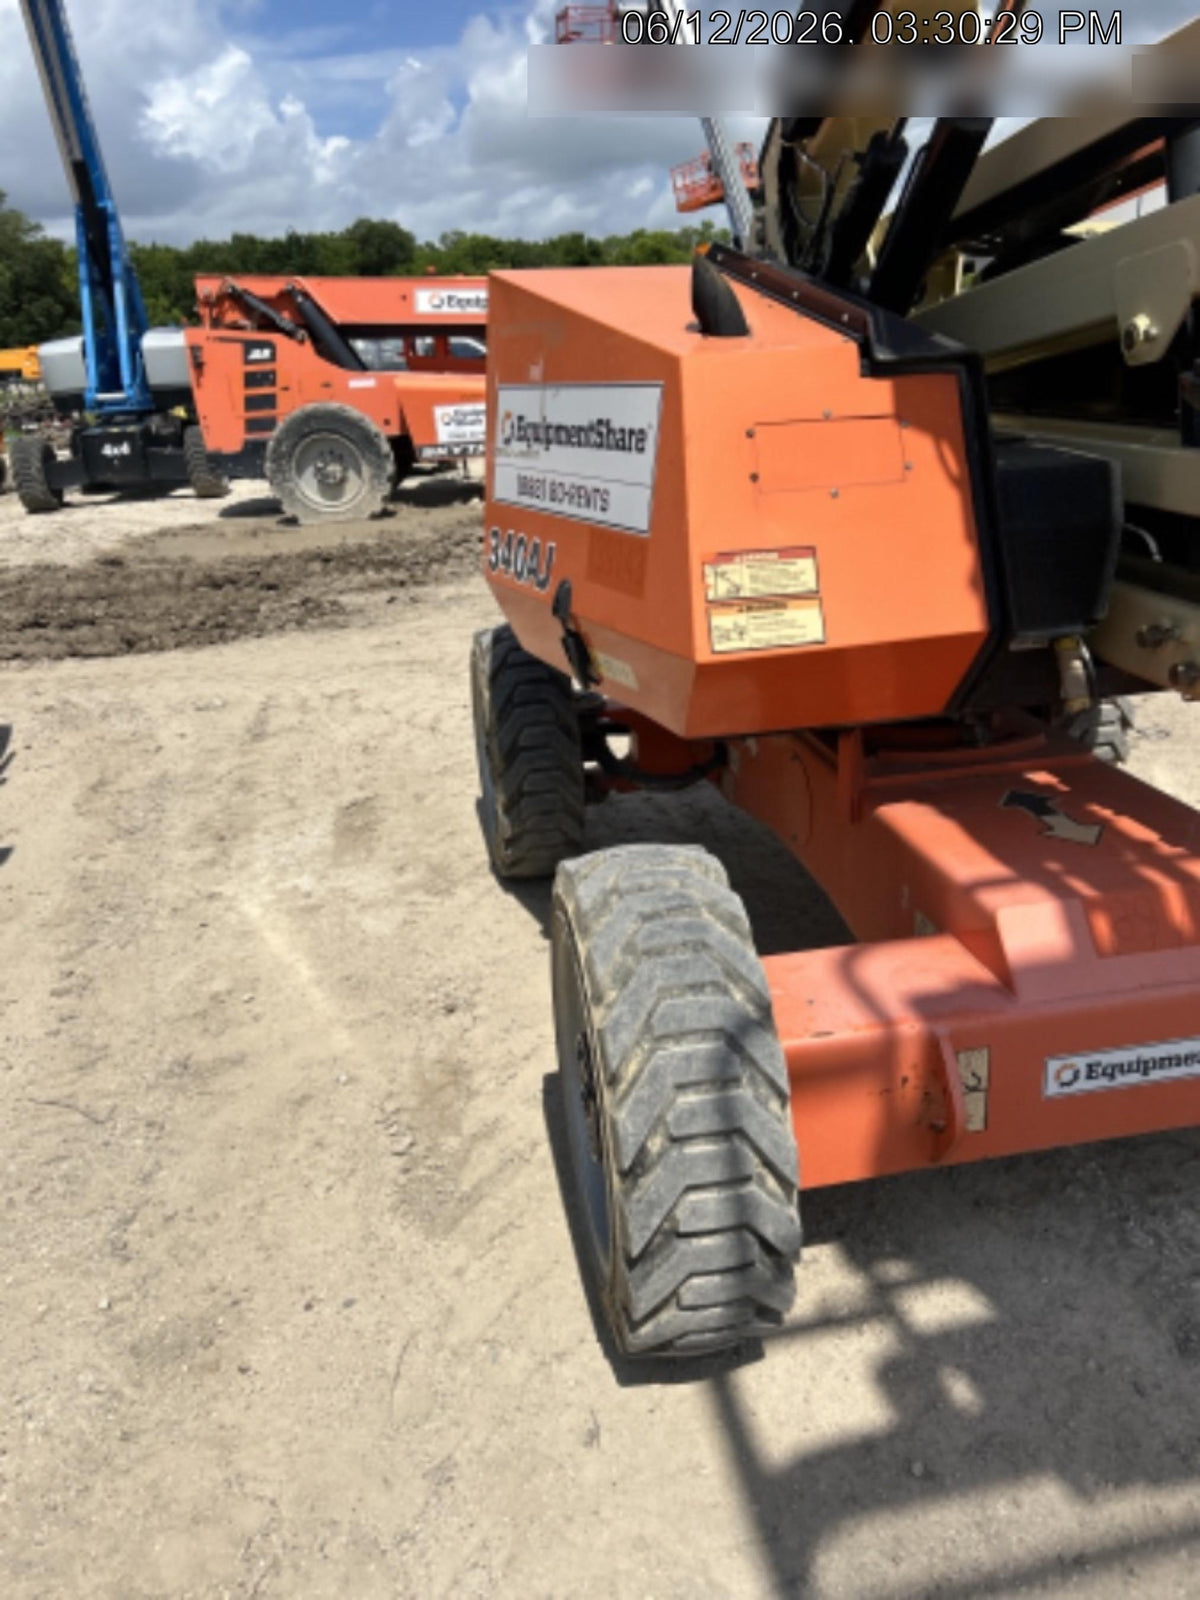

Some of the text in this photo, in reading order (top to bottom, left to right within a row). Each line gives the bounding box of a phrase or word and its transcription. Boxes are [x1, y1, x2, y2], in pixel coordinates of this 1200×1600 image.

[101, 441, 131, 458] 4x4
[516, 415, 649, 454] EquipmentShare
[487, 527, 556, 592] 340AJ
